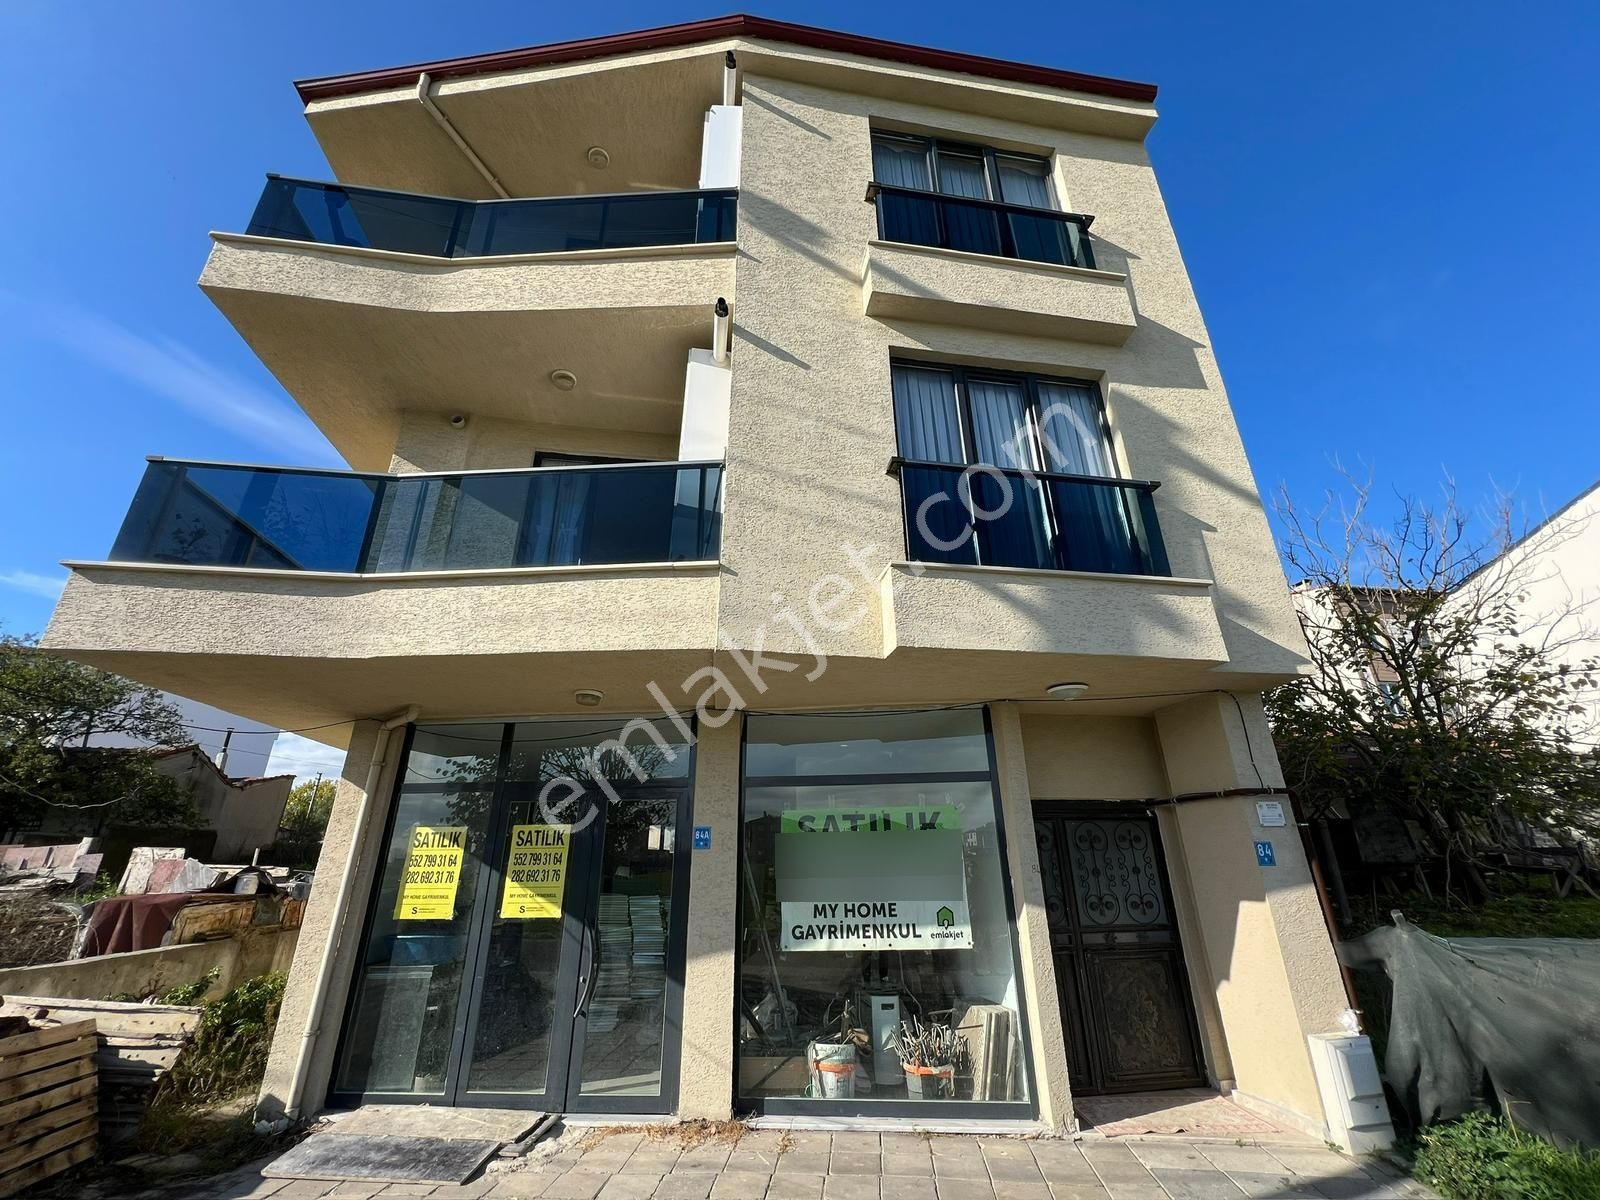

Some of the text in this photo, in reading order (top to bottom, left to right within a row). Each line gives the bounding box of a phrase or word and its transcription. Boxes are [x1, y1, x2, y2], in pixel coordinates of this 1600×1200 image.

[413, 831, 462, 849] SATILIK
[516, 830, 565, 847] SATILIK
[695, 830, 709, 840] 84A
[1257, 843, 1272, 857] 84
[409, 854, 458, 868] 552 799 31 64
[513, 852, 563, 866] 552 799 31 64
[406, 871, 455, 884] 282 692 31 76
[511, 869, 561, 883] 282 692 31 76
[813, 902, 898, 919] MY HOME
[791, 920, 922, 940] GAYRİMENKUL
[930, 930, 964, 941] emlakjet
